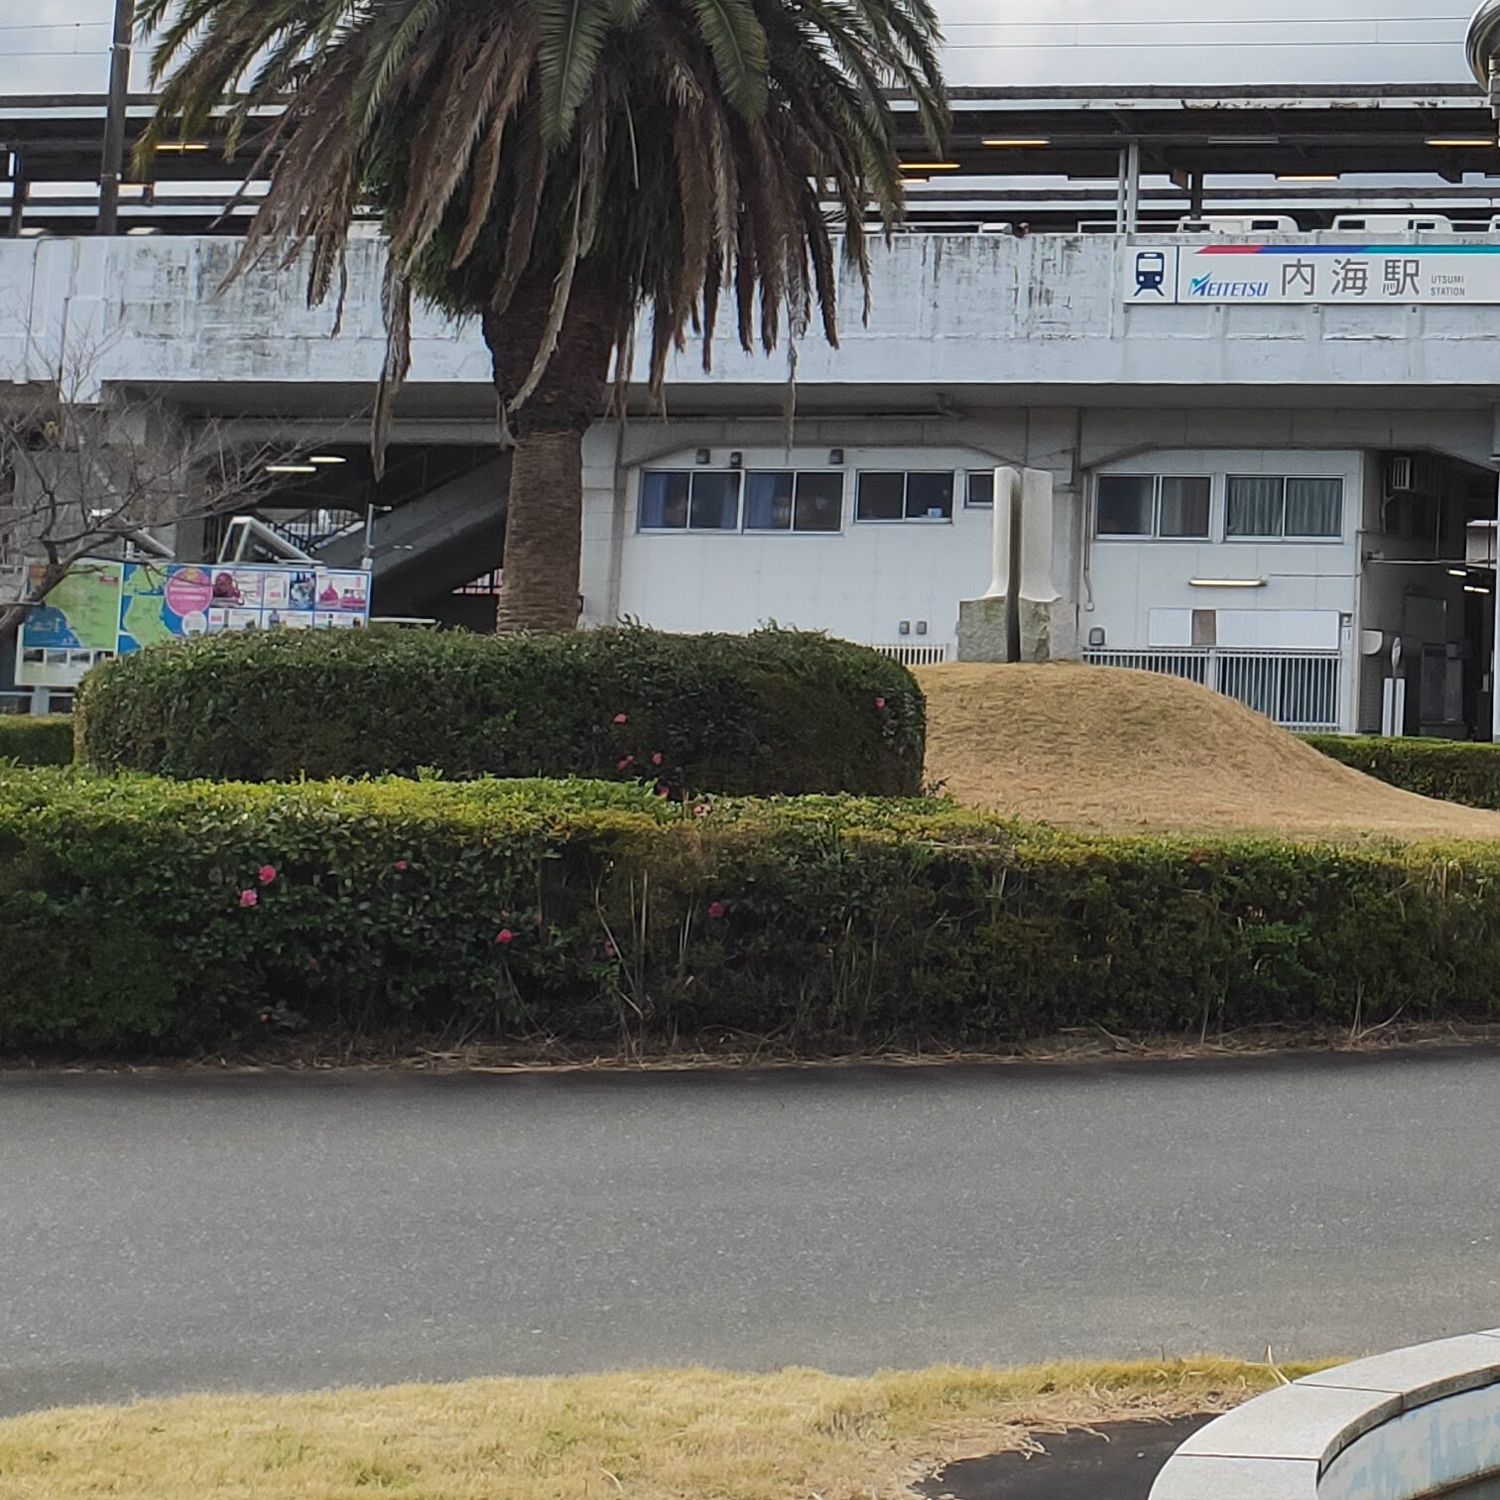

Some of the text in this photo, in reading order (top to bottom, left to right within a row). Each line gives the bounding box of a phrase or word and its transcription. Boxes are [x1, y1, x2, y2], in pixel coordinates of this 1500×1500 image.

[1188, 271, 1269, 296] MEITETSU
[1281, 258, 1420, 296] 内海駅
[1431, 274, 1464, 284] UTSUMI
[1430, 287, 1465, 296] STATION
